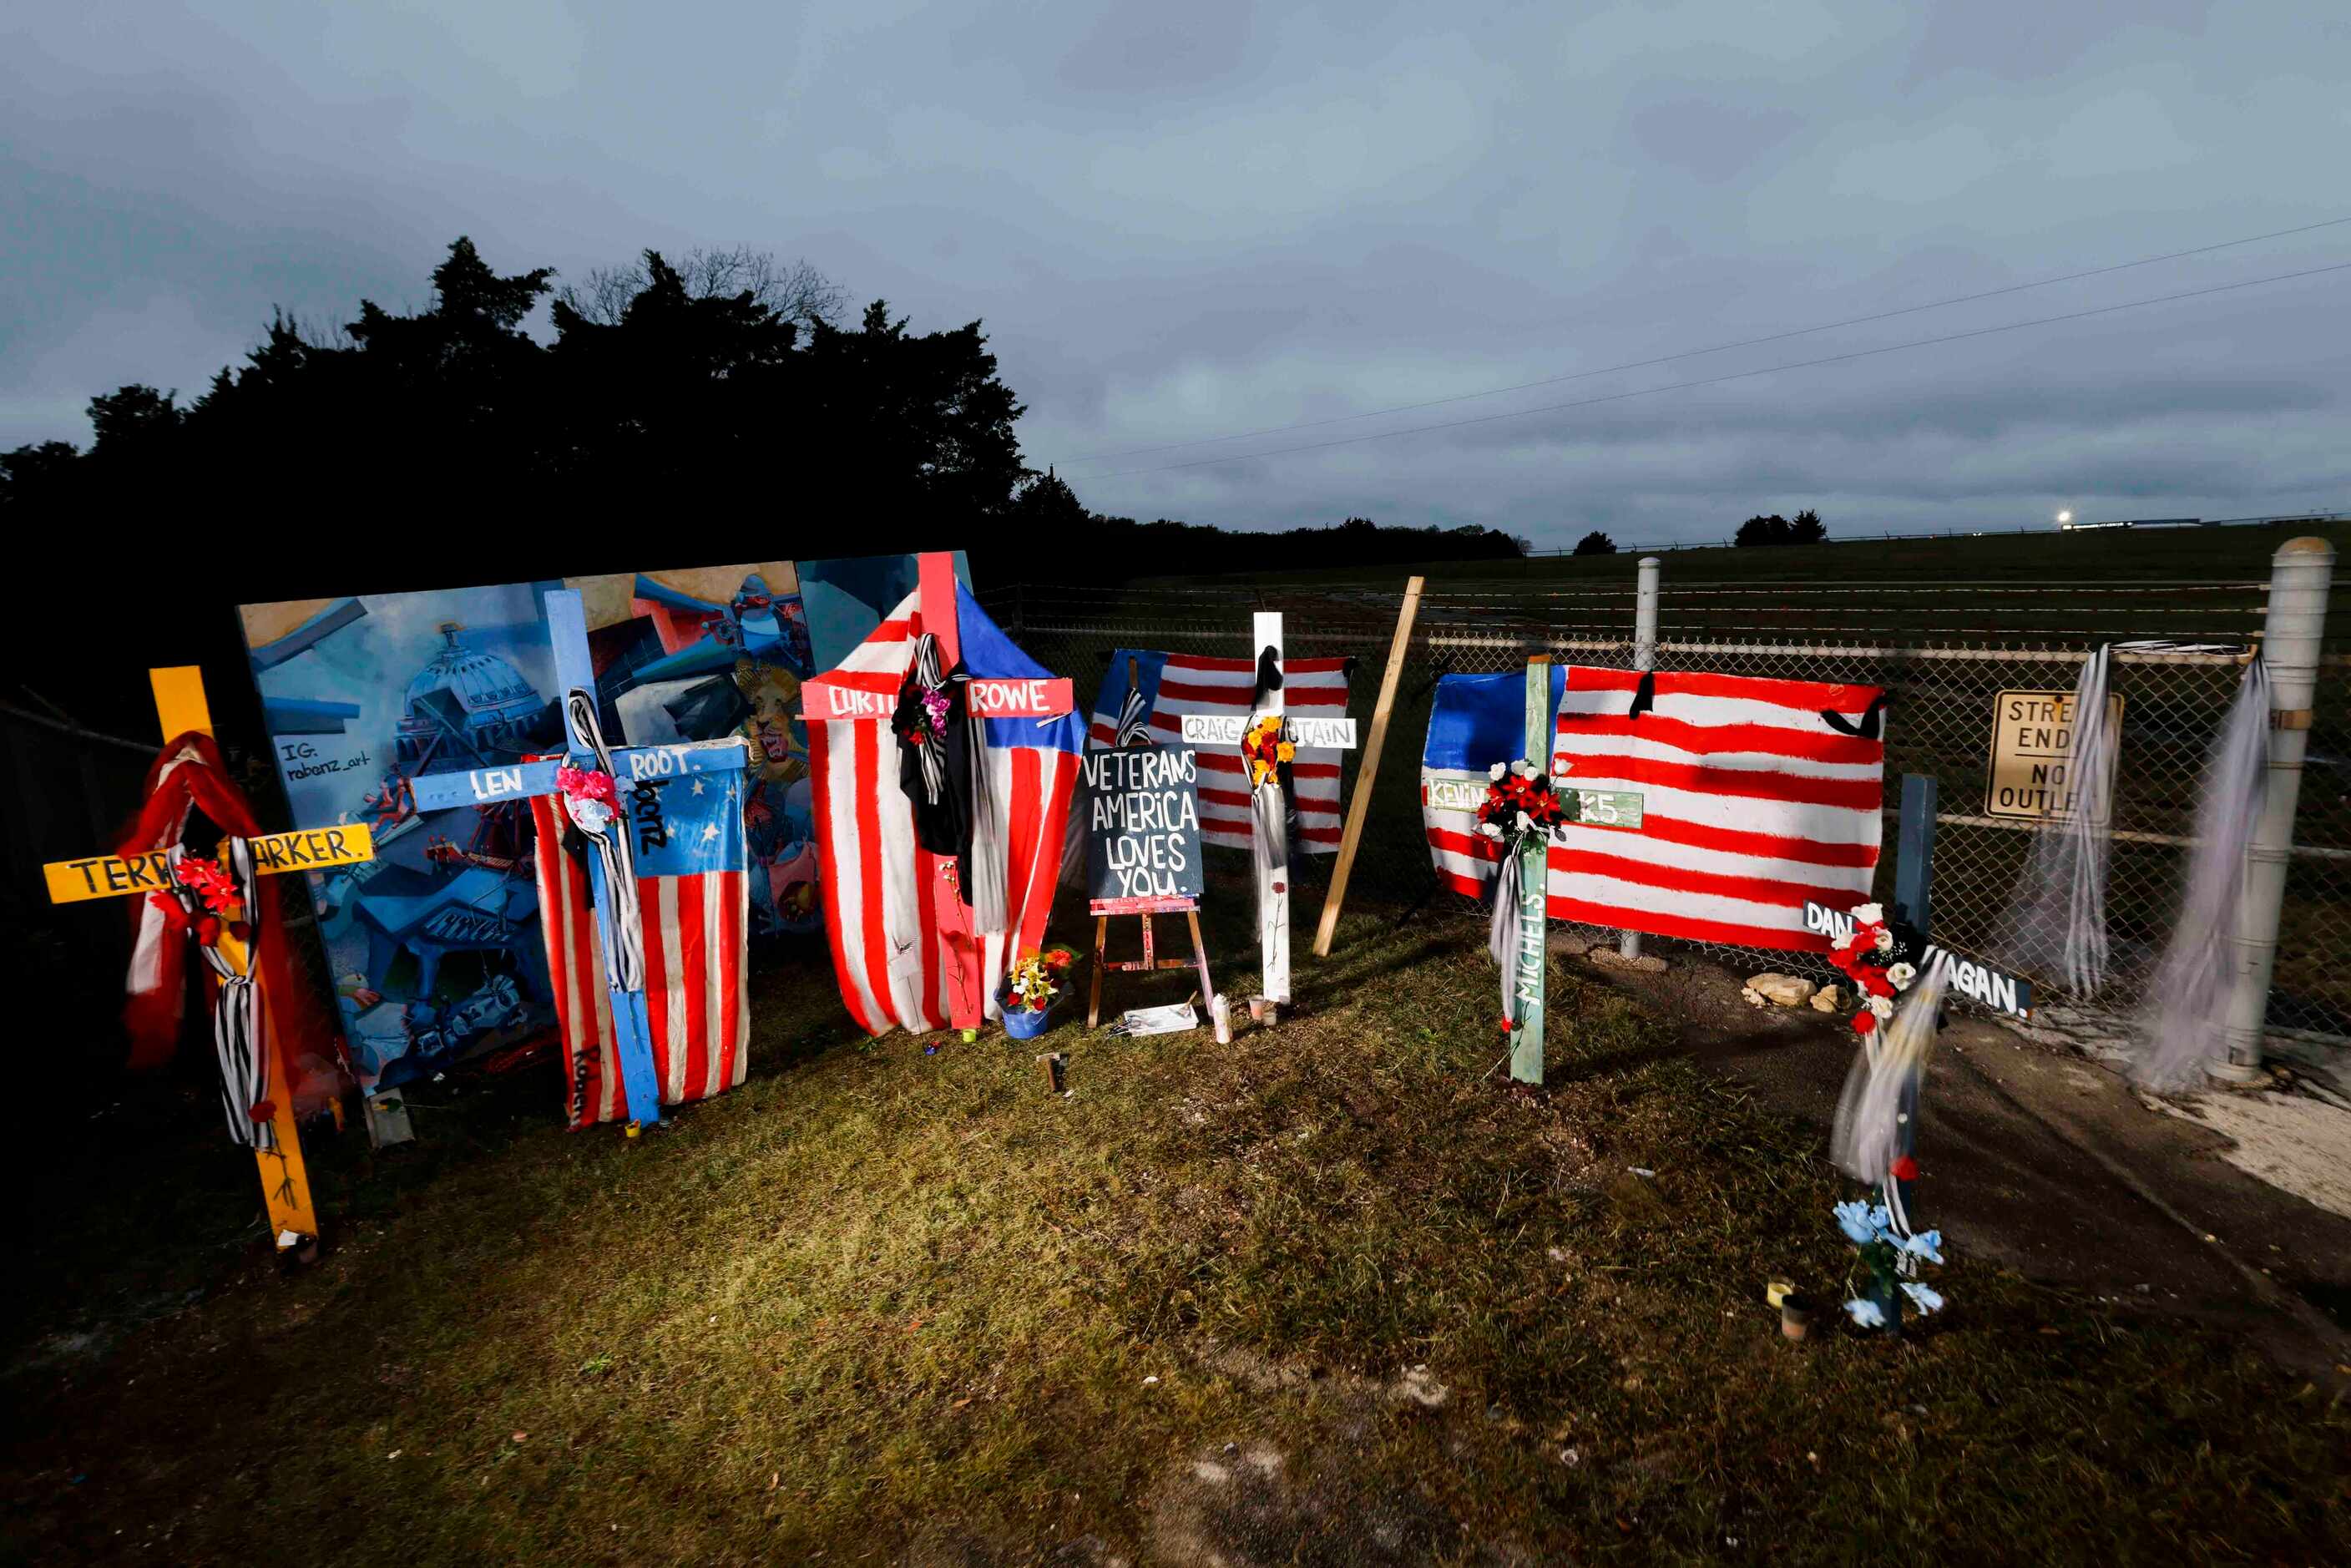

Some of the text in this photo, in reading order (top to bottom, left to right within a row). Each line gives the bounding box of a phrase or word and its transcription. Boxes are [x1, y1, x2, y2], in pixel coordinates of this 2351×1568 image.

[828, 680, 1050, 715] CURTI ROWE
[2008, 701, 2073, 723] STRE
[2018, 727, 2071, 749] END
[469, 748, 701, 800] LEN ROOT.
[1083, 750, 1196, 791] VETERANS
[2031, 764, 2066, 785] NO
[632, 779, 670, 855] benz
[1578, 791, 1618, 823] K5
[2000, 787, 2079, 812] OUTLE
[69, 830, 363, 893] TERR ARKER.
[1105, 832, 1186, 873] LOVES
[1117, 866, 1188, 898] YOU.
[1807, 902, 2028, 1018] DAN AGAN.
